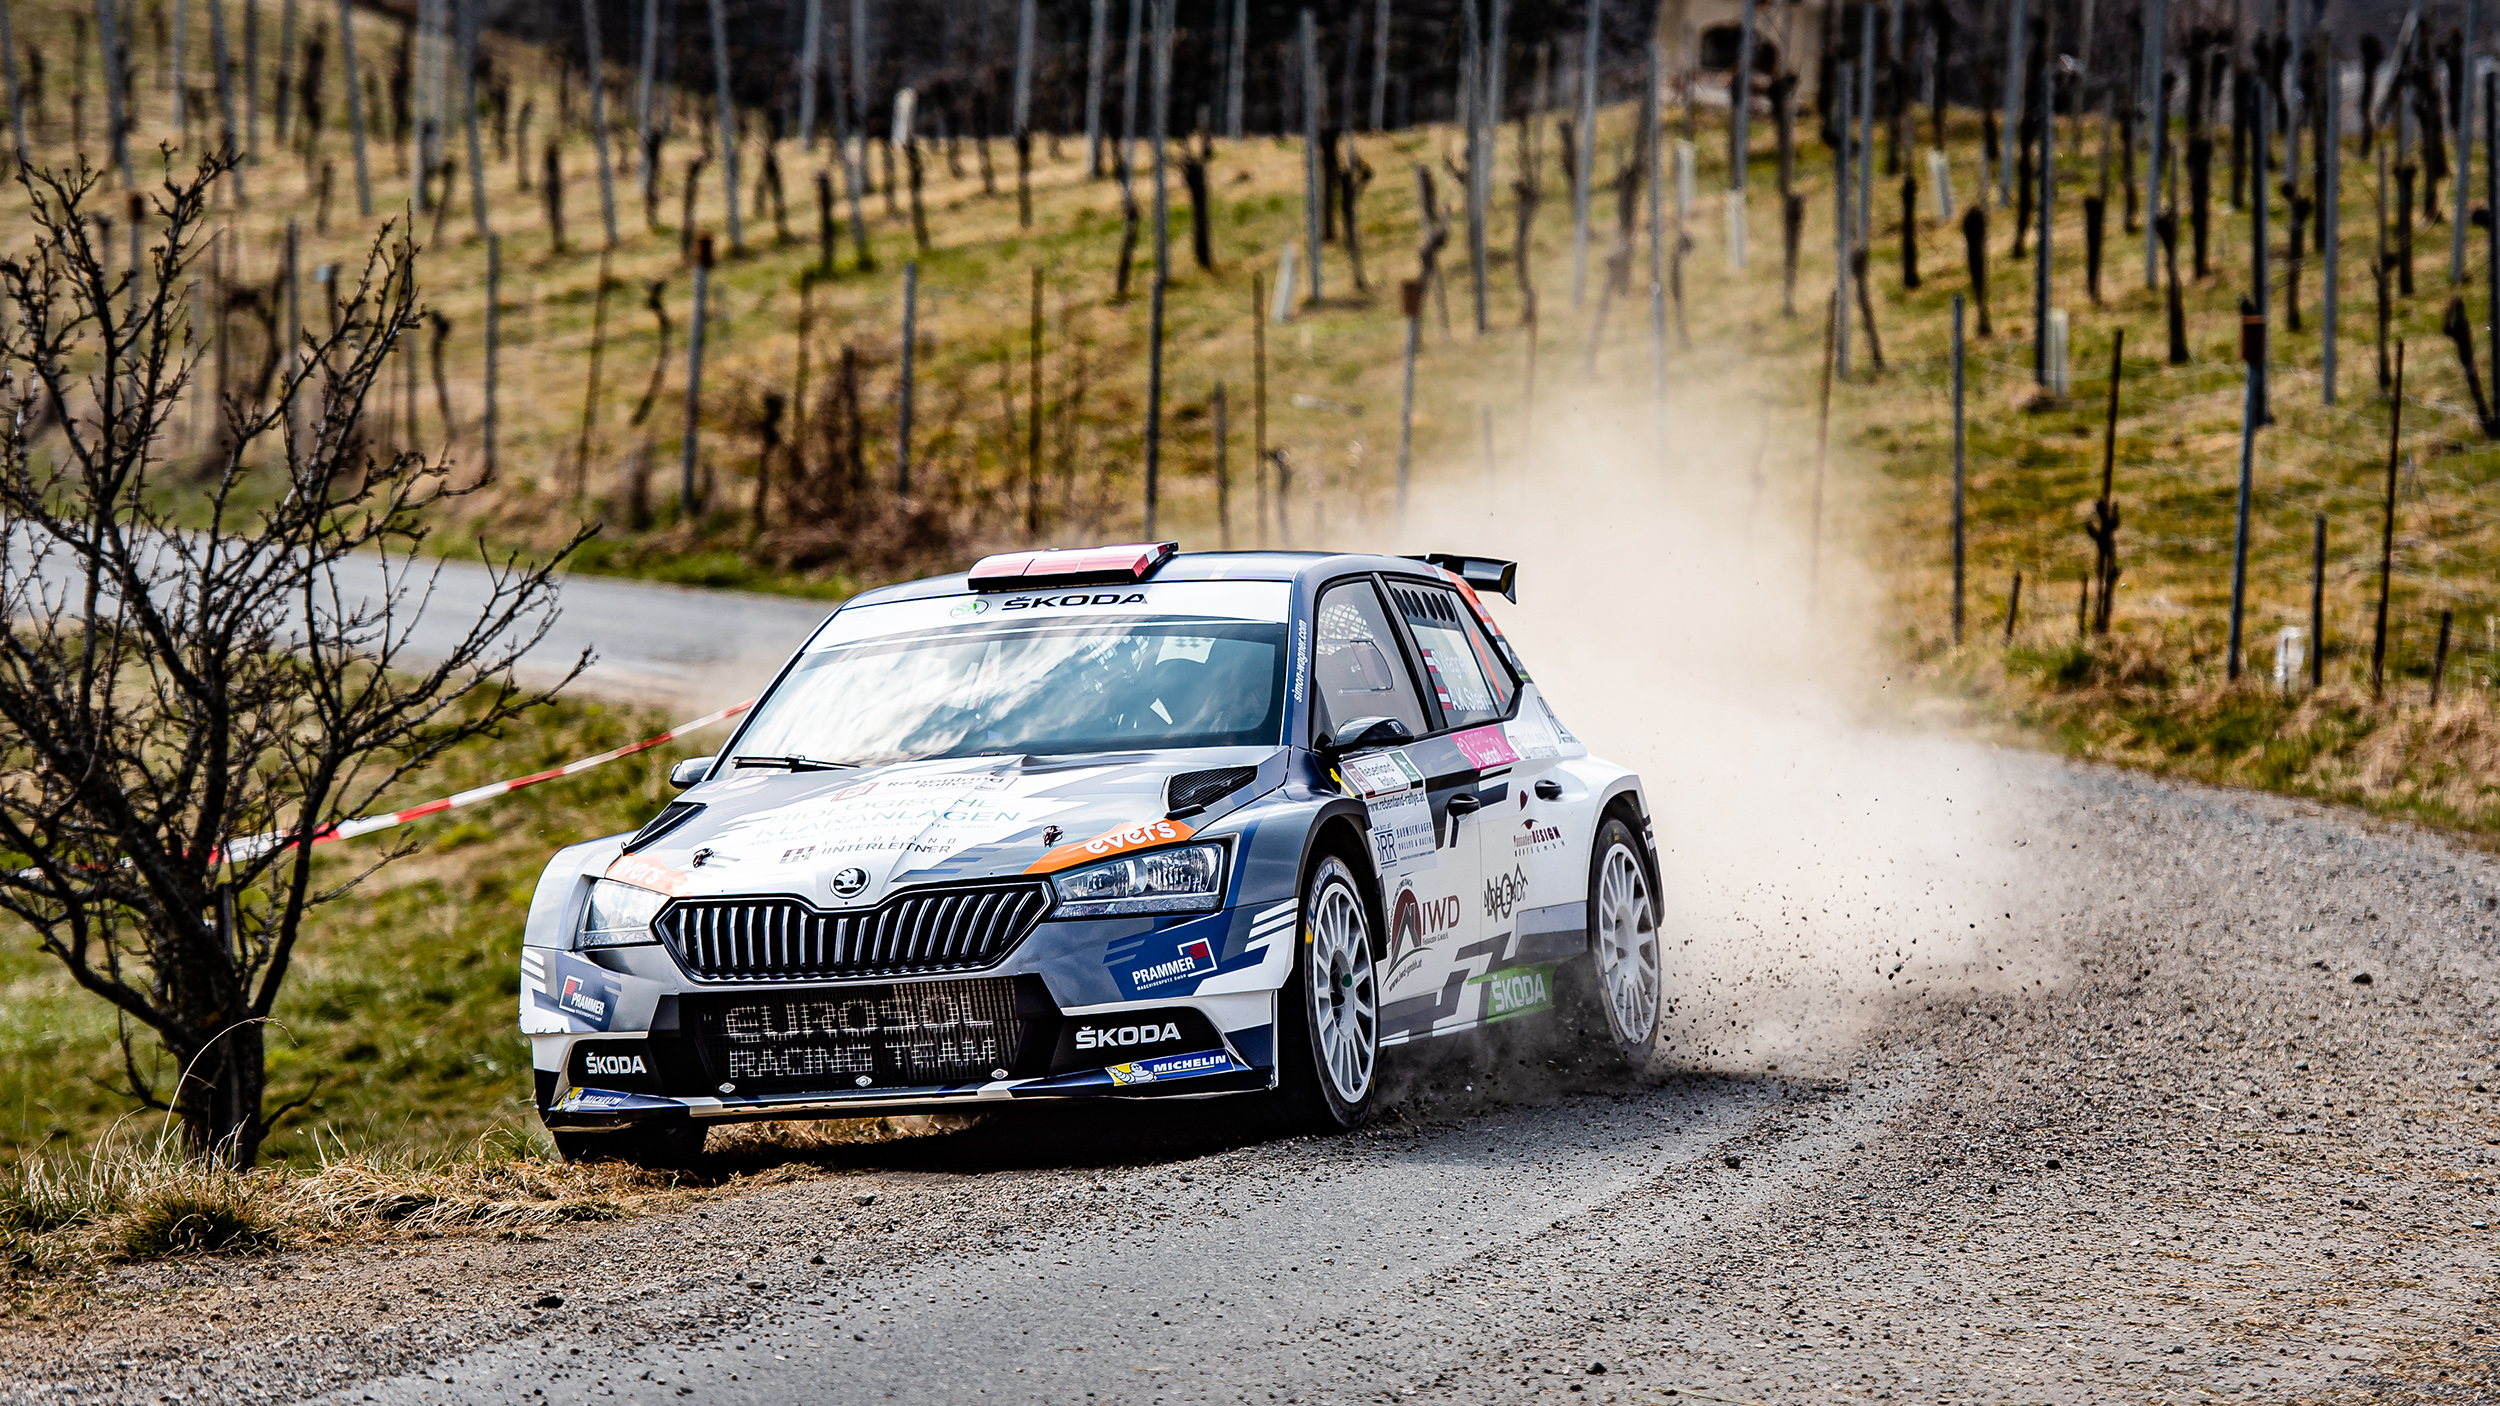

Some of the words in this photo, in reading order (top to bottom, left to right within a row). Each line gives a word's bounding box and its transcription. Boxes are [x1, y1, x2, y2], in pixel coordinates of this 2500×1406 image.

[1001, 594, 1148, 611] ŠKODA
[1291, 619, 1308, 703] simon-wagner.com
[1470, 627, 1506, 702] 1
[1358, 762, 1395, 777] Rebenland
[1377, 776, 1398, 787] Rallye
[769, 797, 996, 824] BIOLOGISCHE
[815, 842, 951, 857] HINTERLEITNER
[821, 834, 957, 846] AUTOLAND
[1085, 822, 1176, 854] evers
[612, 858, 667, 884] evers
[1422, 895, 1460, 936] IWD
[1132, 956, 1196, 985] PRAMMER
[571, 992, 605, 1015] PRAMMER
[1491, 974, 1547, 1012] ŠKODA
[726, 993, 993, 1043] EUROSOL
[1075, 1022, 1182, 1050] ŠKODA
[586, 1052, 647, 1075] ŠKODA
[730, 1043, 873, 1078] RACING
[885, 1037, 996, 1069] TEAM
[1153, 1055, 1226, 1073] MICHELIN
[581, 1095, 624, 1106] MICHELIN
